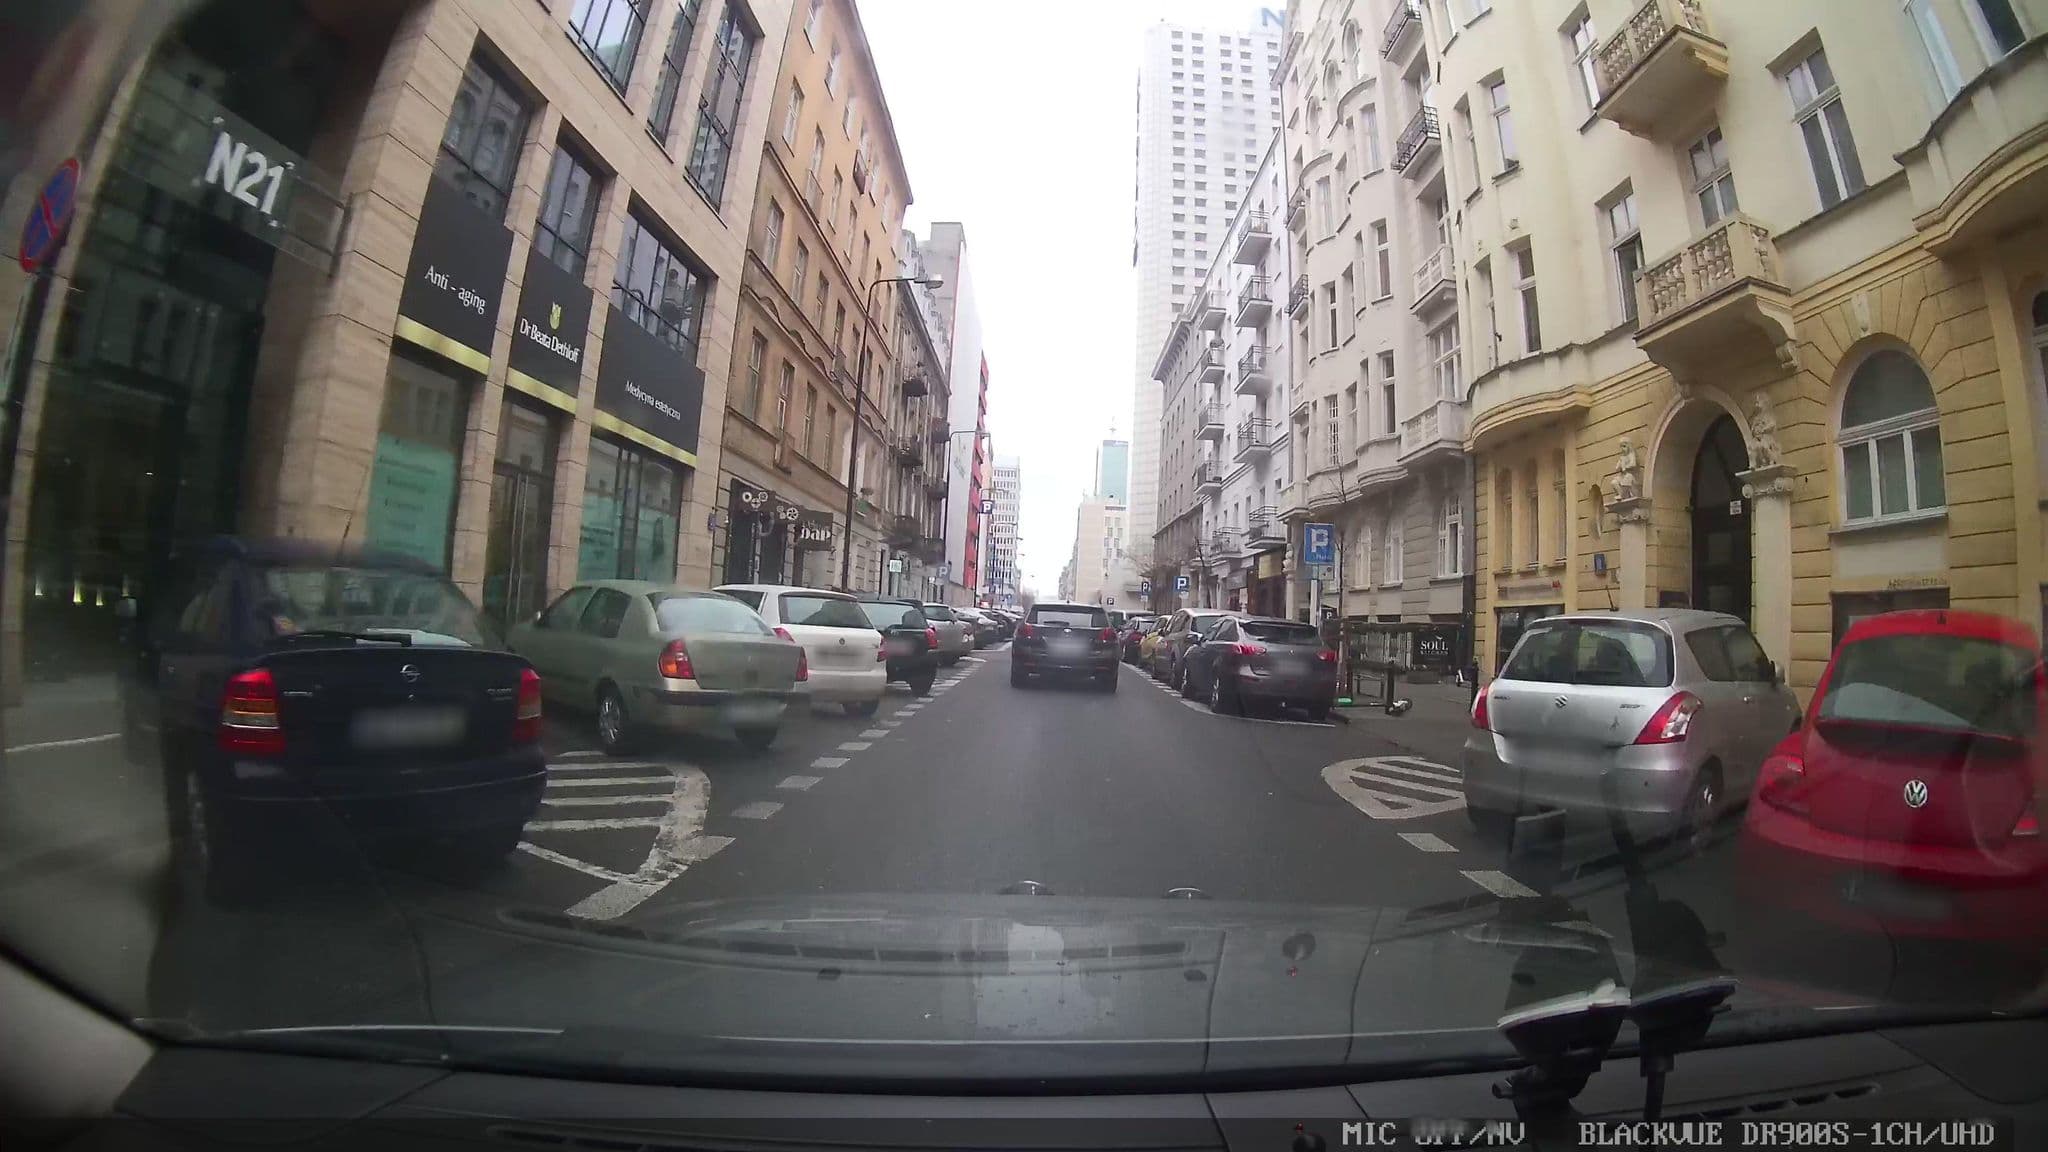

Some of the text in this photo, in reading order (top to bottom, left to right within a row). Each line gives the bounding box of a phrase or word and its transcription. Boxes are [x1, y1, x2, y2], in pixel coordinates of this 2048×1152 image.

[205, 131, 284, 214] N21
[424, 265, 450, 290] Anti
[458, 287, 486, 315] aging
[519, 318, 581, 363] Dr Beata Dethloff
[625, 380, 655, 406] Medycyna
[983, 501, 991, 512] P
[1311, 528, 1329, 553] P
[939, 567, 948, 579] P
[1177, 577, 1187, 590] P
[1420, 640, 1449, 651] SOUL
